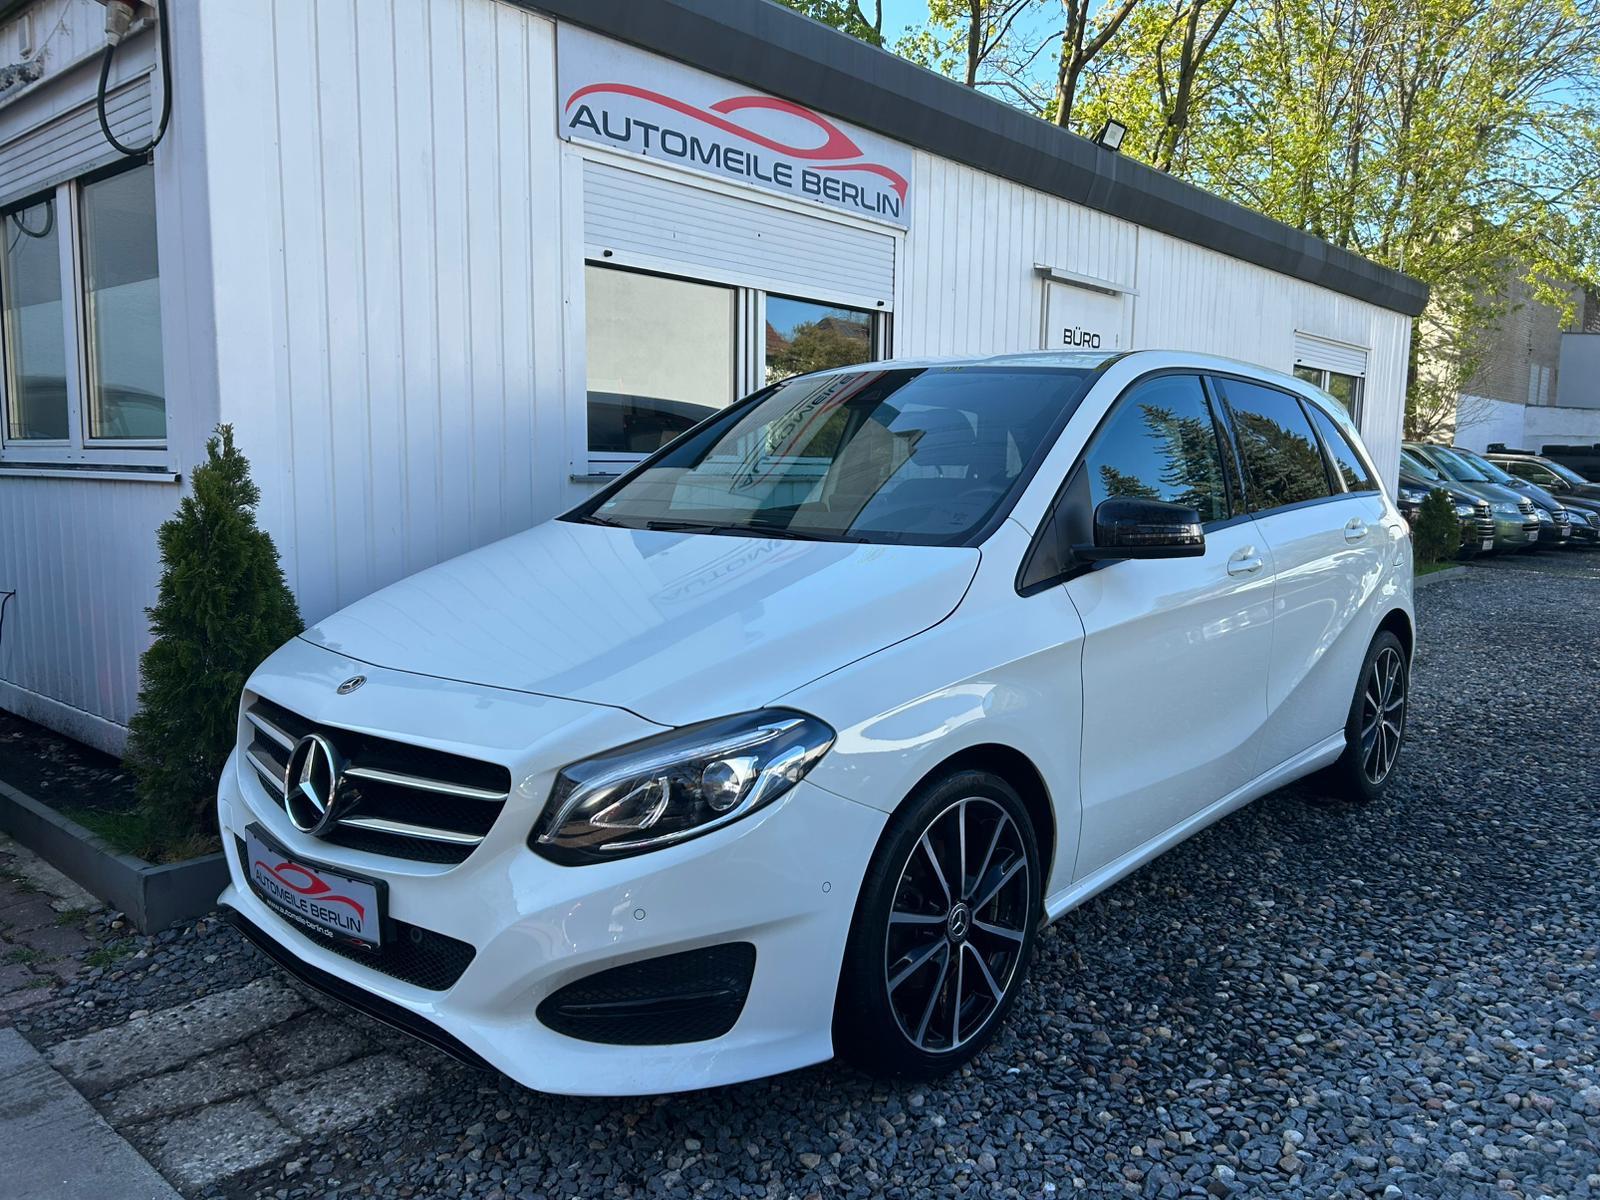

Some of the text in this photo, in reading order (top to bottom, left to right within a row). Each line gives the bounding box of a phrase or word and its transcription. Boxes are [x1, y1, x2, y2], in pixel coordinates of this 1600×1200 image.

[568, 104, 900, 218] AUTOMEILE BERLIN
[1063, 326, 1101, 349] BÜRO
[256, 869, 361, 933] AUTOMEILE BERLIN
